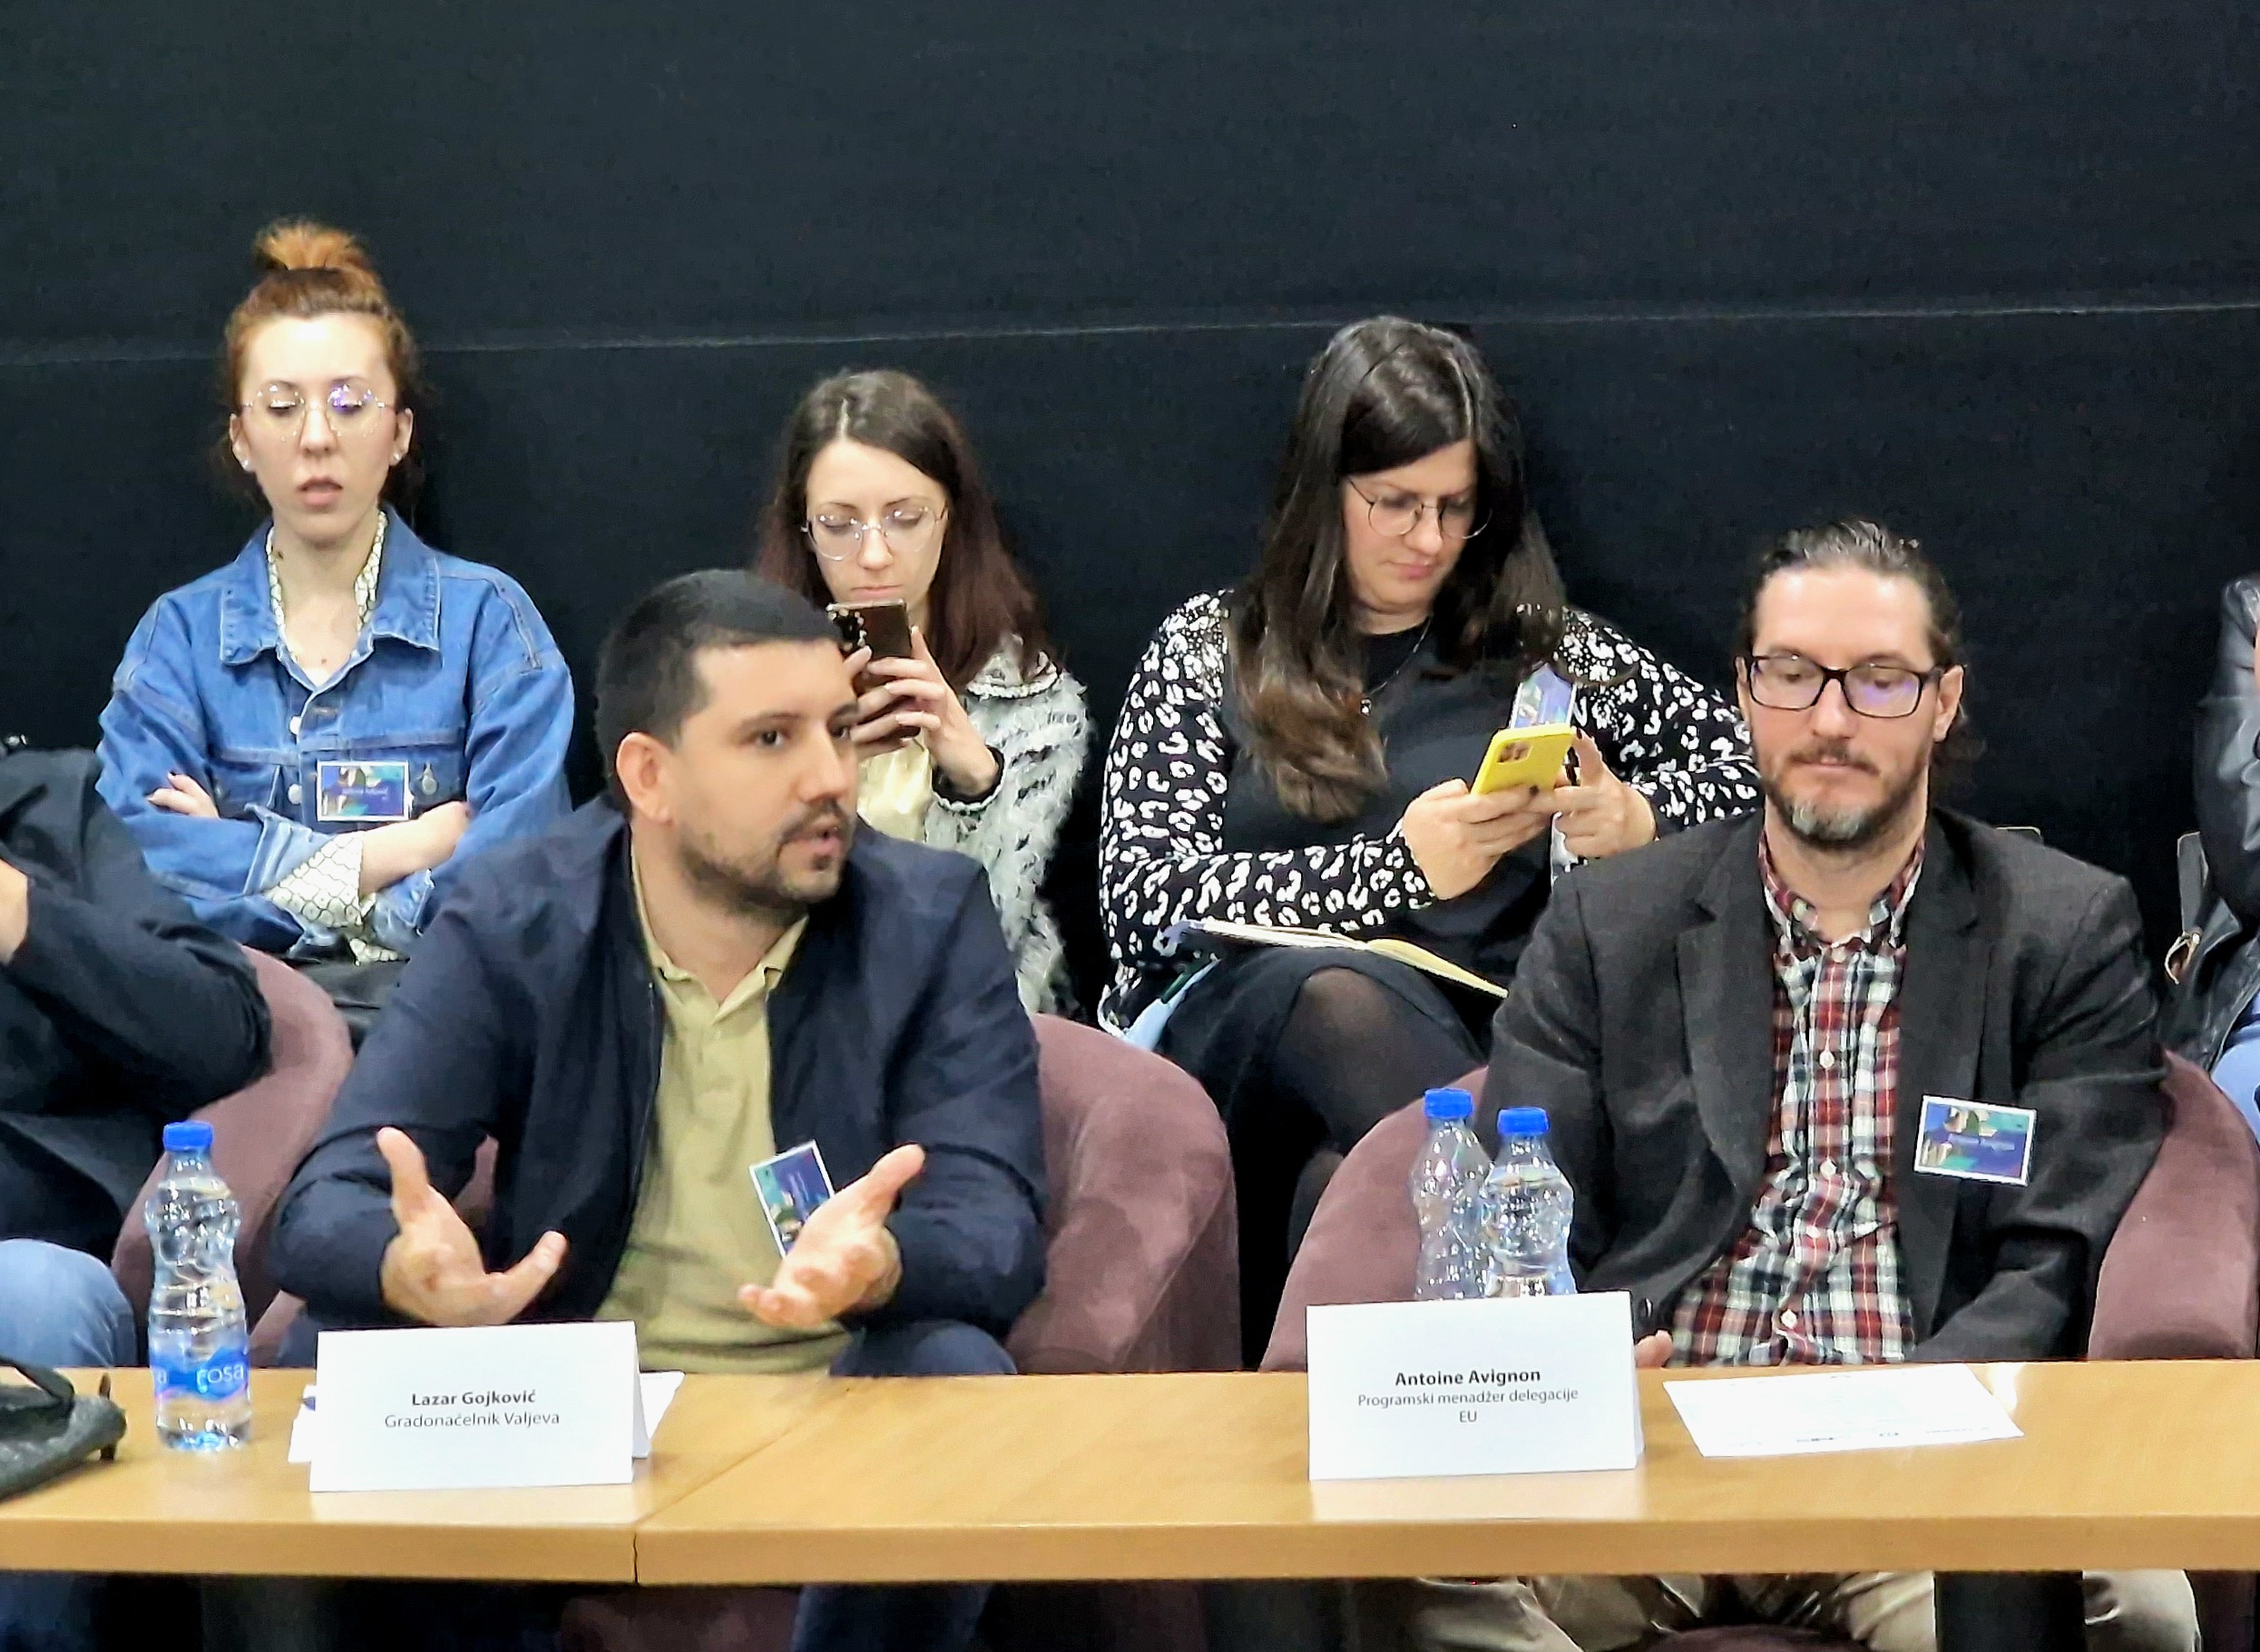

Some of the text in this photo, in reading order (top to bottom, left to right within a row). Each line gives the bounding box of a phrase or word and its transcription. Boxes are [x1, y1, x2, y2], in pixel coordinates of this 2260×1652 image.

[1394, 1368, 1541, 1386] Antoine Avignon
[411, 1389, 537, 1407] Lazar Gojković
[1357, 1387, 1579, 1409] Programski menadžer delegacije
[504, 1410, 561, 1428] Valjeva
[1459, 1410, 1478, 1423] EU
